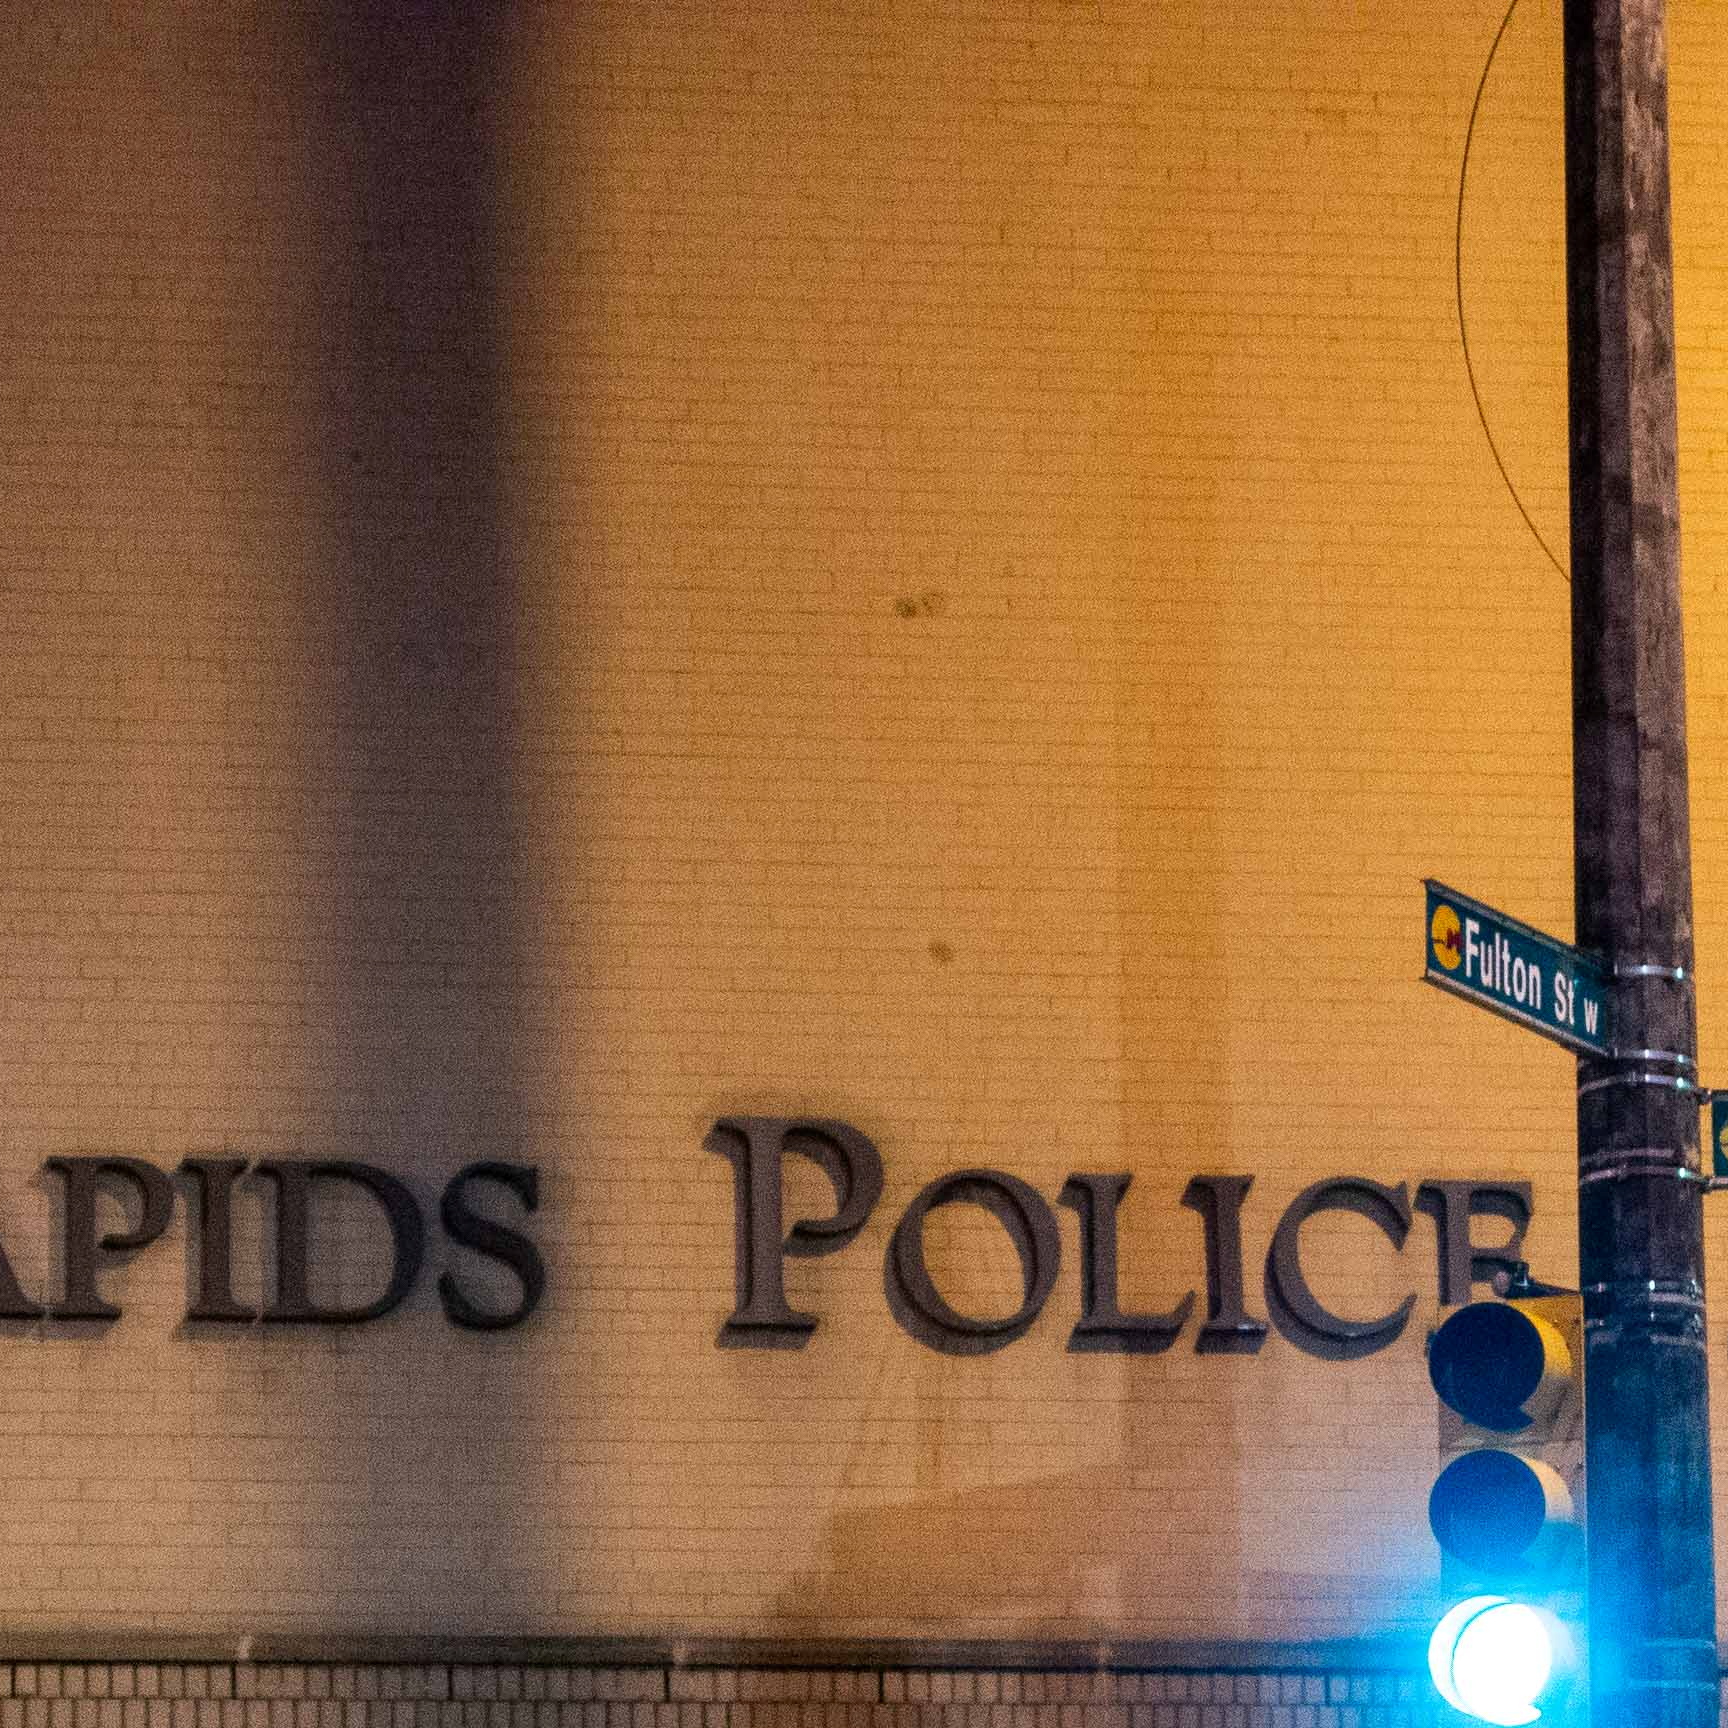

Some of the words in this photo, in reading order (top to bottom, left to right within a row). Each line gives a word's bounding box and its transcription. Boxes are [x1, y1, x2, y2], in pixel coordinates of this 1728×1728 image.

[1465, 917, 1542, 1010] Fulton
[1553, 971, 1575, 1026] St
[702, 1115, 1535, 1358] POLICE
